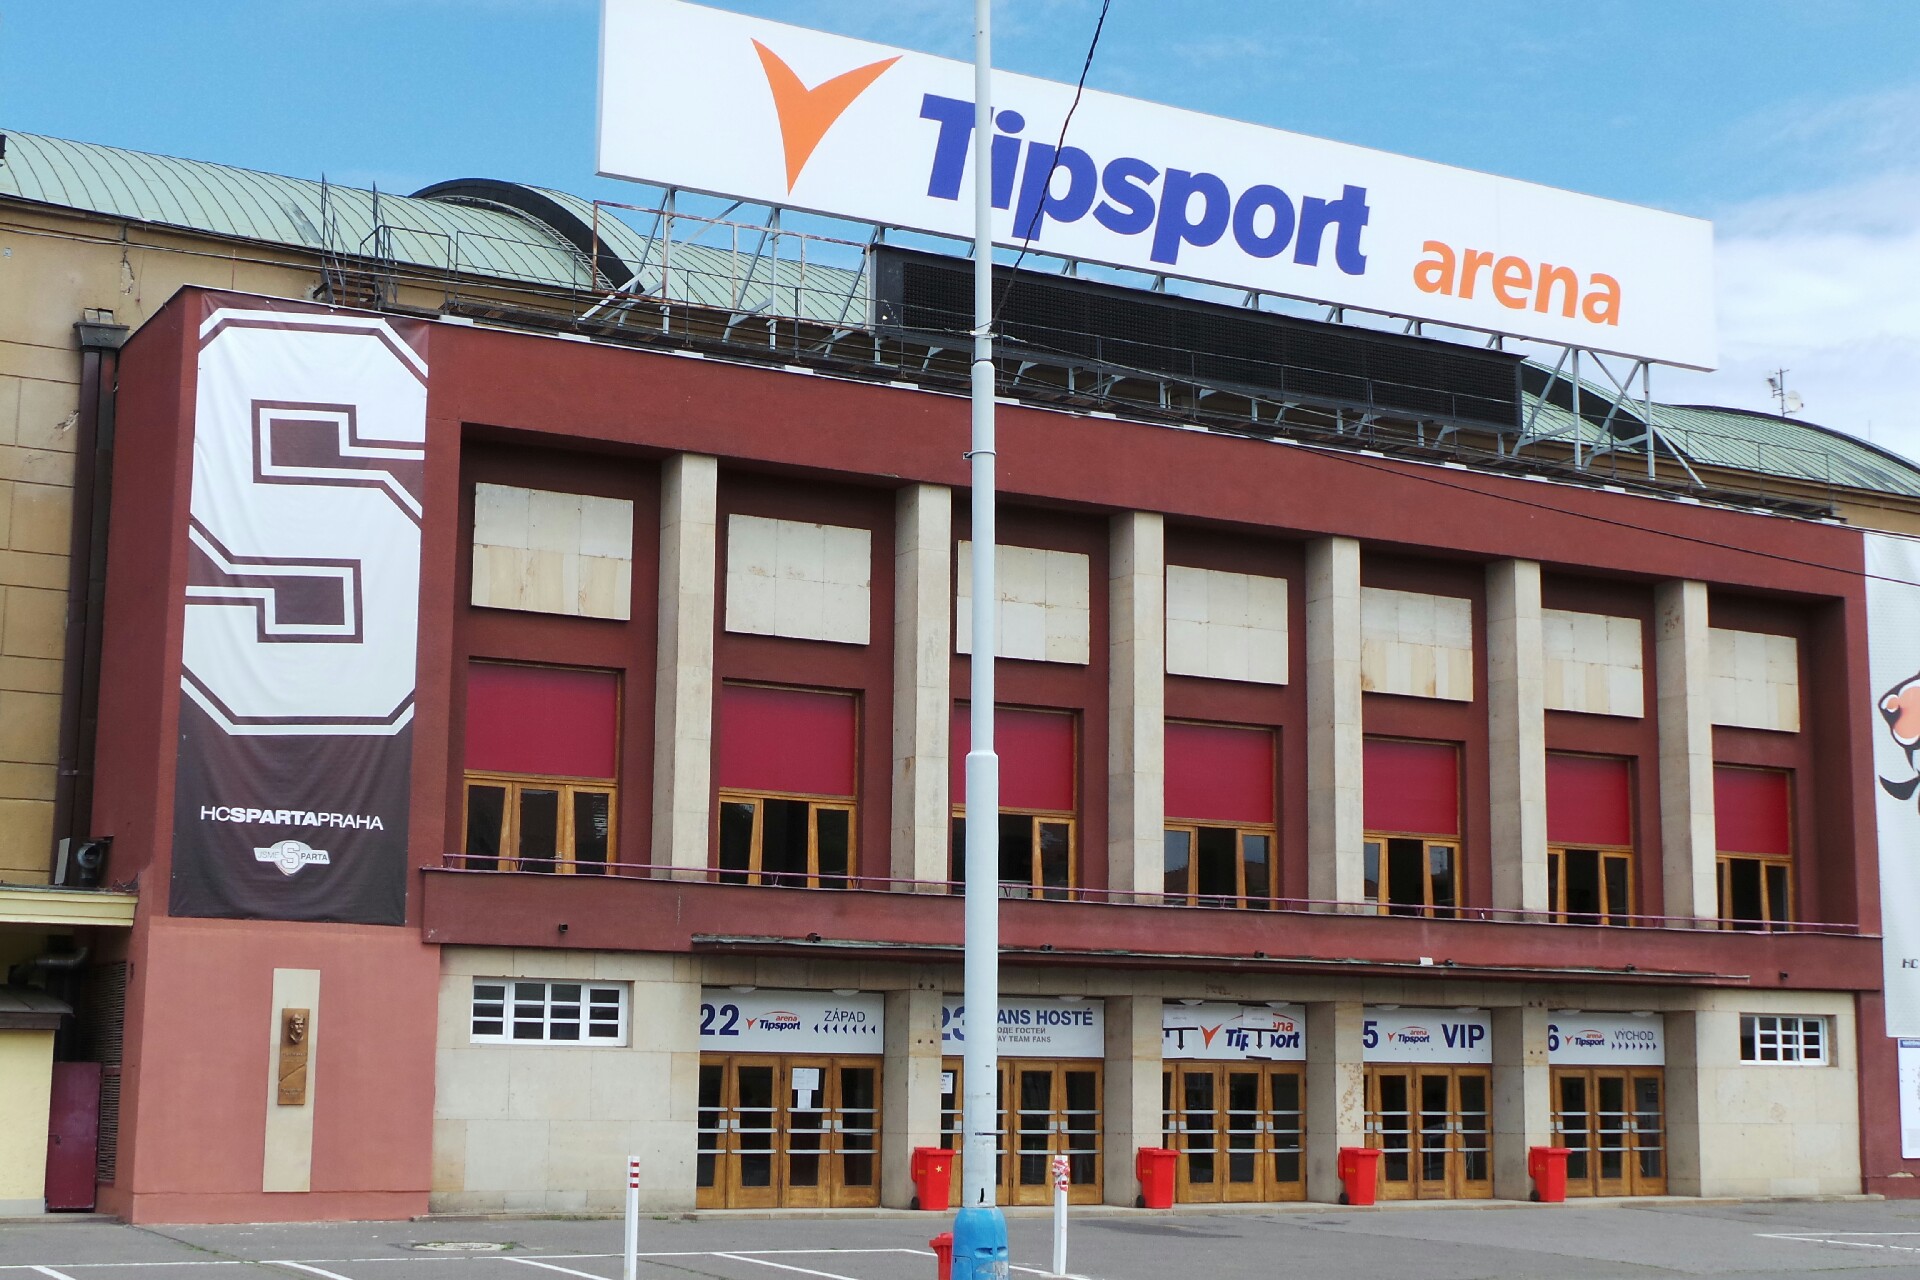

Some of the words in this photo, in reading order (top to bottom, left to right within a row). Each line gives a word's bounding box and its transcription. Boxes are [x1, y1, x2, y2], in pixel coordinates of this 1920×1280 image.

[920, 93, 1370, 275] Tipsport
[1413, 240, 1621, 326] arena
[700, 1003, 740, 1036] 22
[824, 1008, 866, 1023] ZÁPAD
[997, 1009, 1031, 1025] ANS
[1036, 1007, 1094, 1026] HOSTÉ
[759, 1019, 801, 1032] Tipsport
[1008, 1035, 1031, 1043] TEAM
[1225, 1029, 1300, 1051] Tiport
[1398, 1033, 1430, 1044] Tipsport
[1441, 1023, 1485, 1049] VIP
[1614, 1028, 1655, 1041] VÝCHOD
[1574, 1037, 1605, 1048] Tipsport
